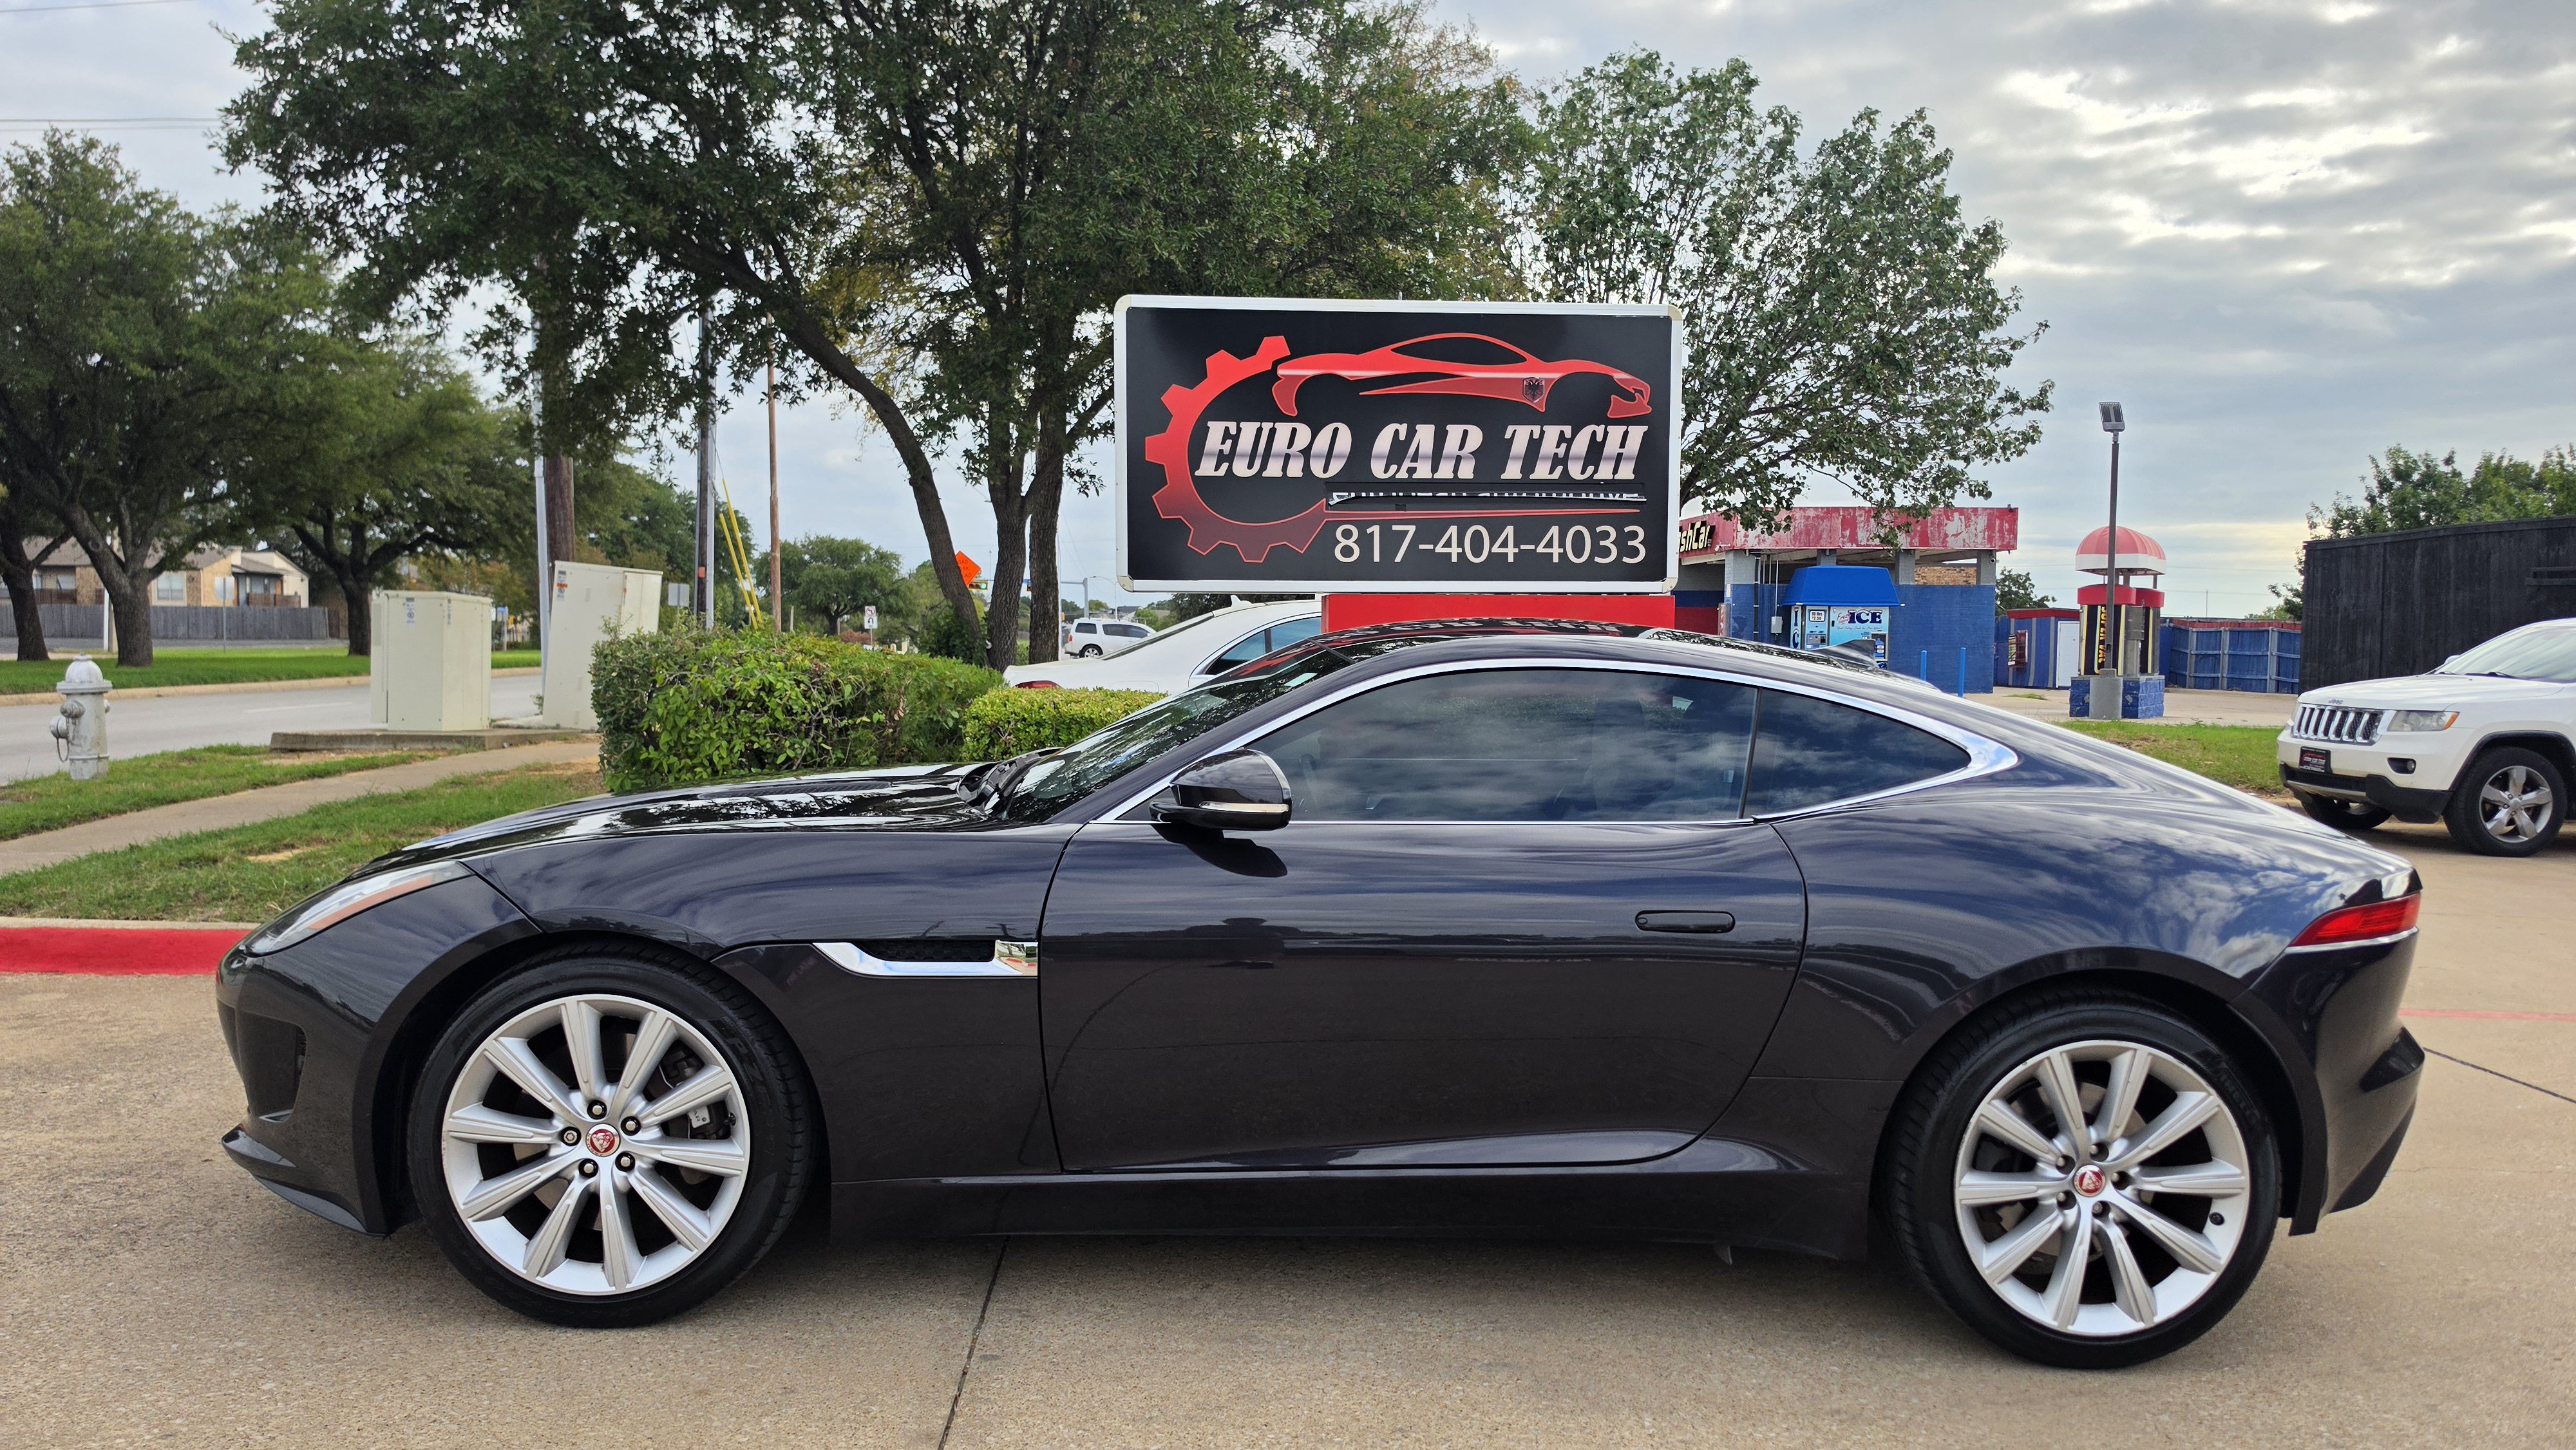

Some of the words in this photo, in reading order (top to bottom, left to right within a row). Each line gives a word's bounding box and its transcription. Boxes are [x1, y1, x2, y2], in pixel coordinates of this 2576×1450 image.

[1195, 422, 1352, 478] EURO
[1371, 423, 1483, 480] CAR
[1501, 424, 1649, 480] TECH
[1334, 524, 1646, 563] 817-404-4033
[1848, 609, 1882, 624] ICE
